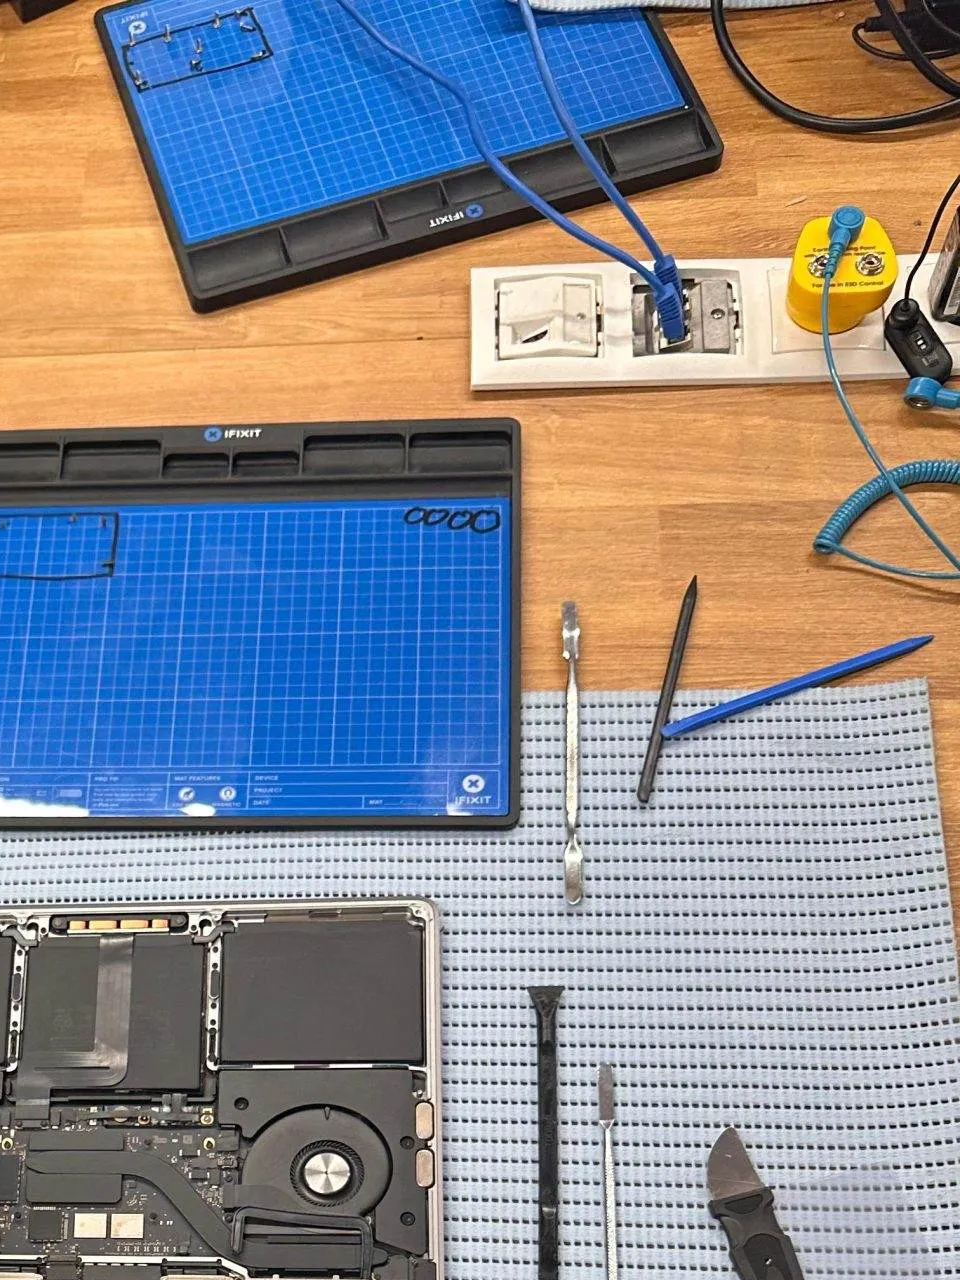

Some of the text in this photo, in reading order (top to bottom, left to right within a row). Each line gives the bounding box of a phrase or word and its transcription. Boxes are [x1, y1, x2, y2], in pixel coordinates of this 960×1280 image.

[429, 211, 464, 228] IFIXIT
[224, 429, 262, 439] IFIXIT
[454, 795, 492, 805] IFIXIT
